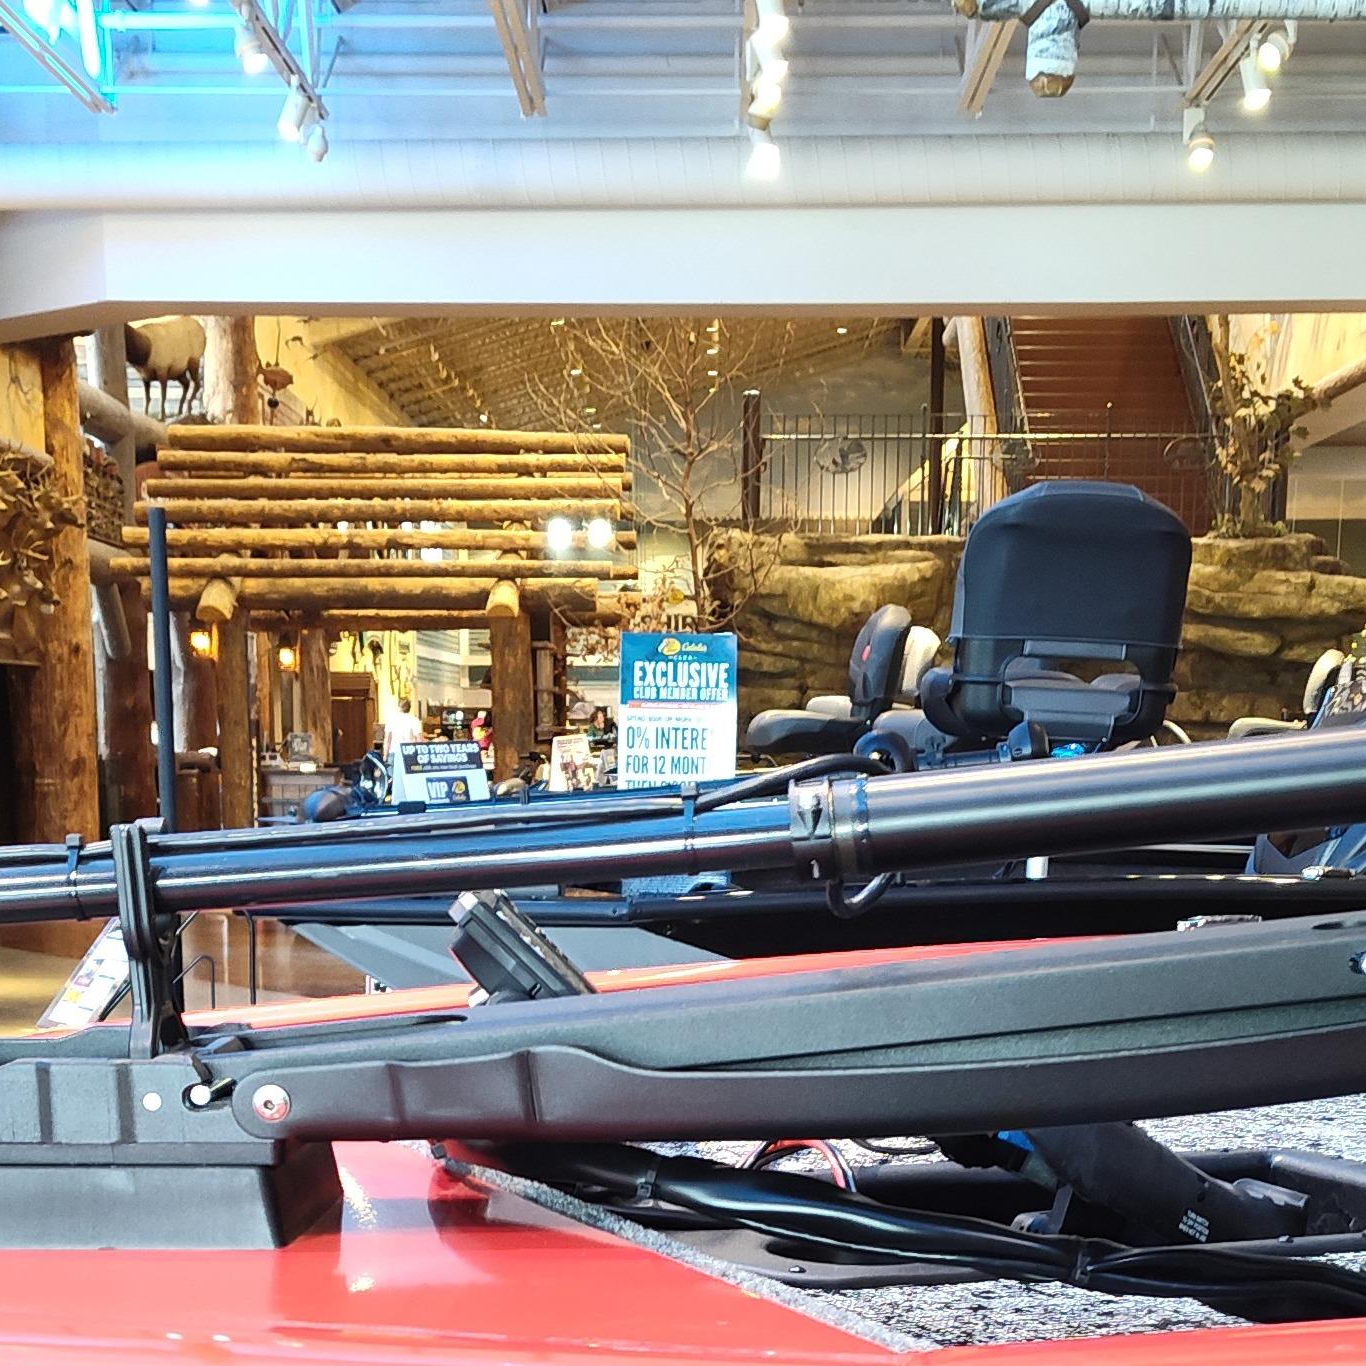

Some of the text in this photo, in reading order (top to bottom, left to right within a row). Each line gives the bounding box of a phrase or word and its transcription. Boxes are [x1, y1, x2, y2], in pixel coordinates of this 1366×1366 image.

[633, 660, 730, 688] EXCLUSIVE
[626, 726, 709, 750] 0% INTERE
[625, 754, 707, 775] FOR 12 MONT
[427, 781, 449, 798] VIP
